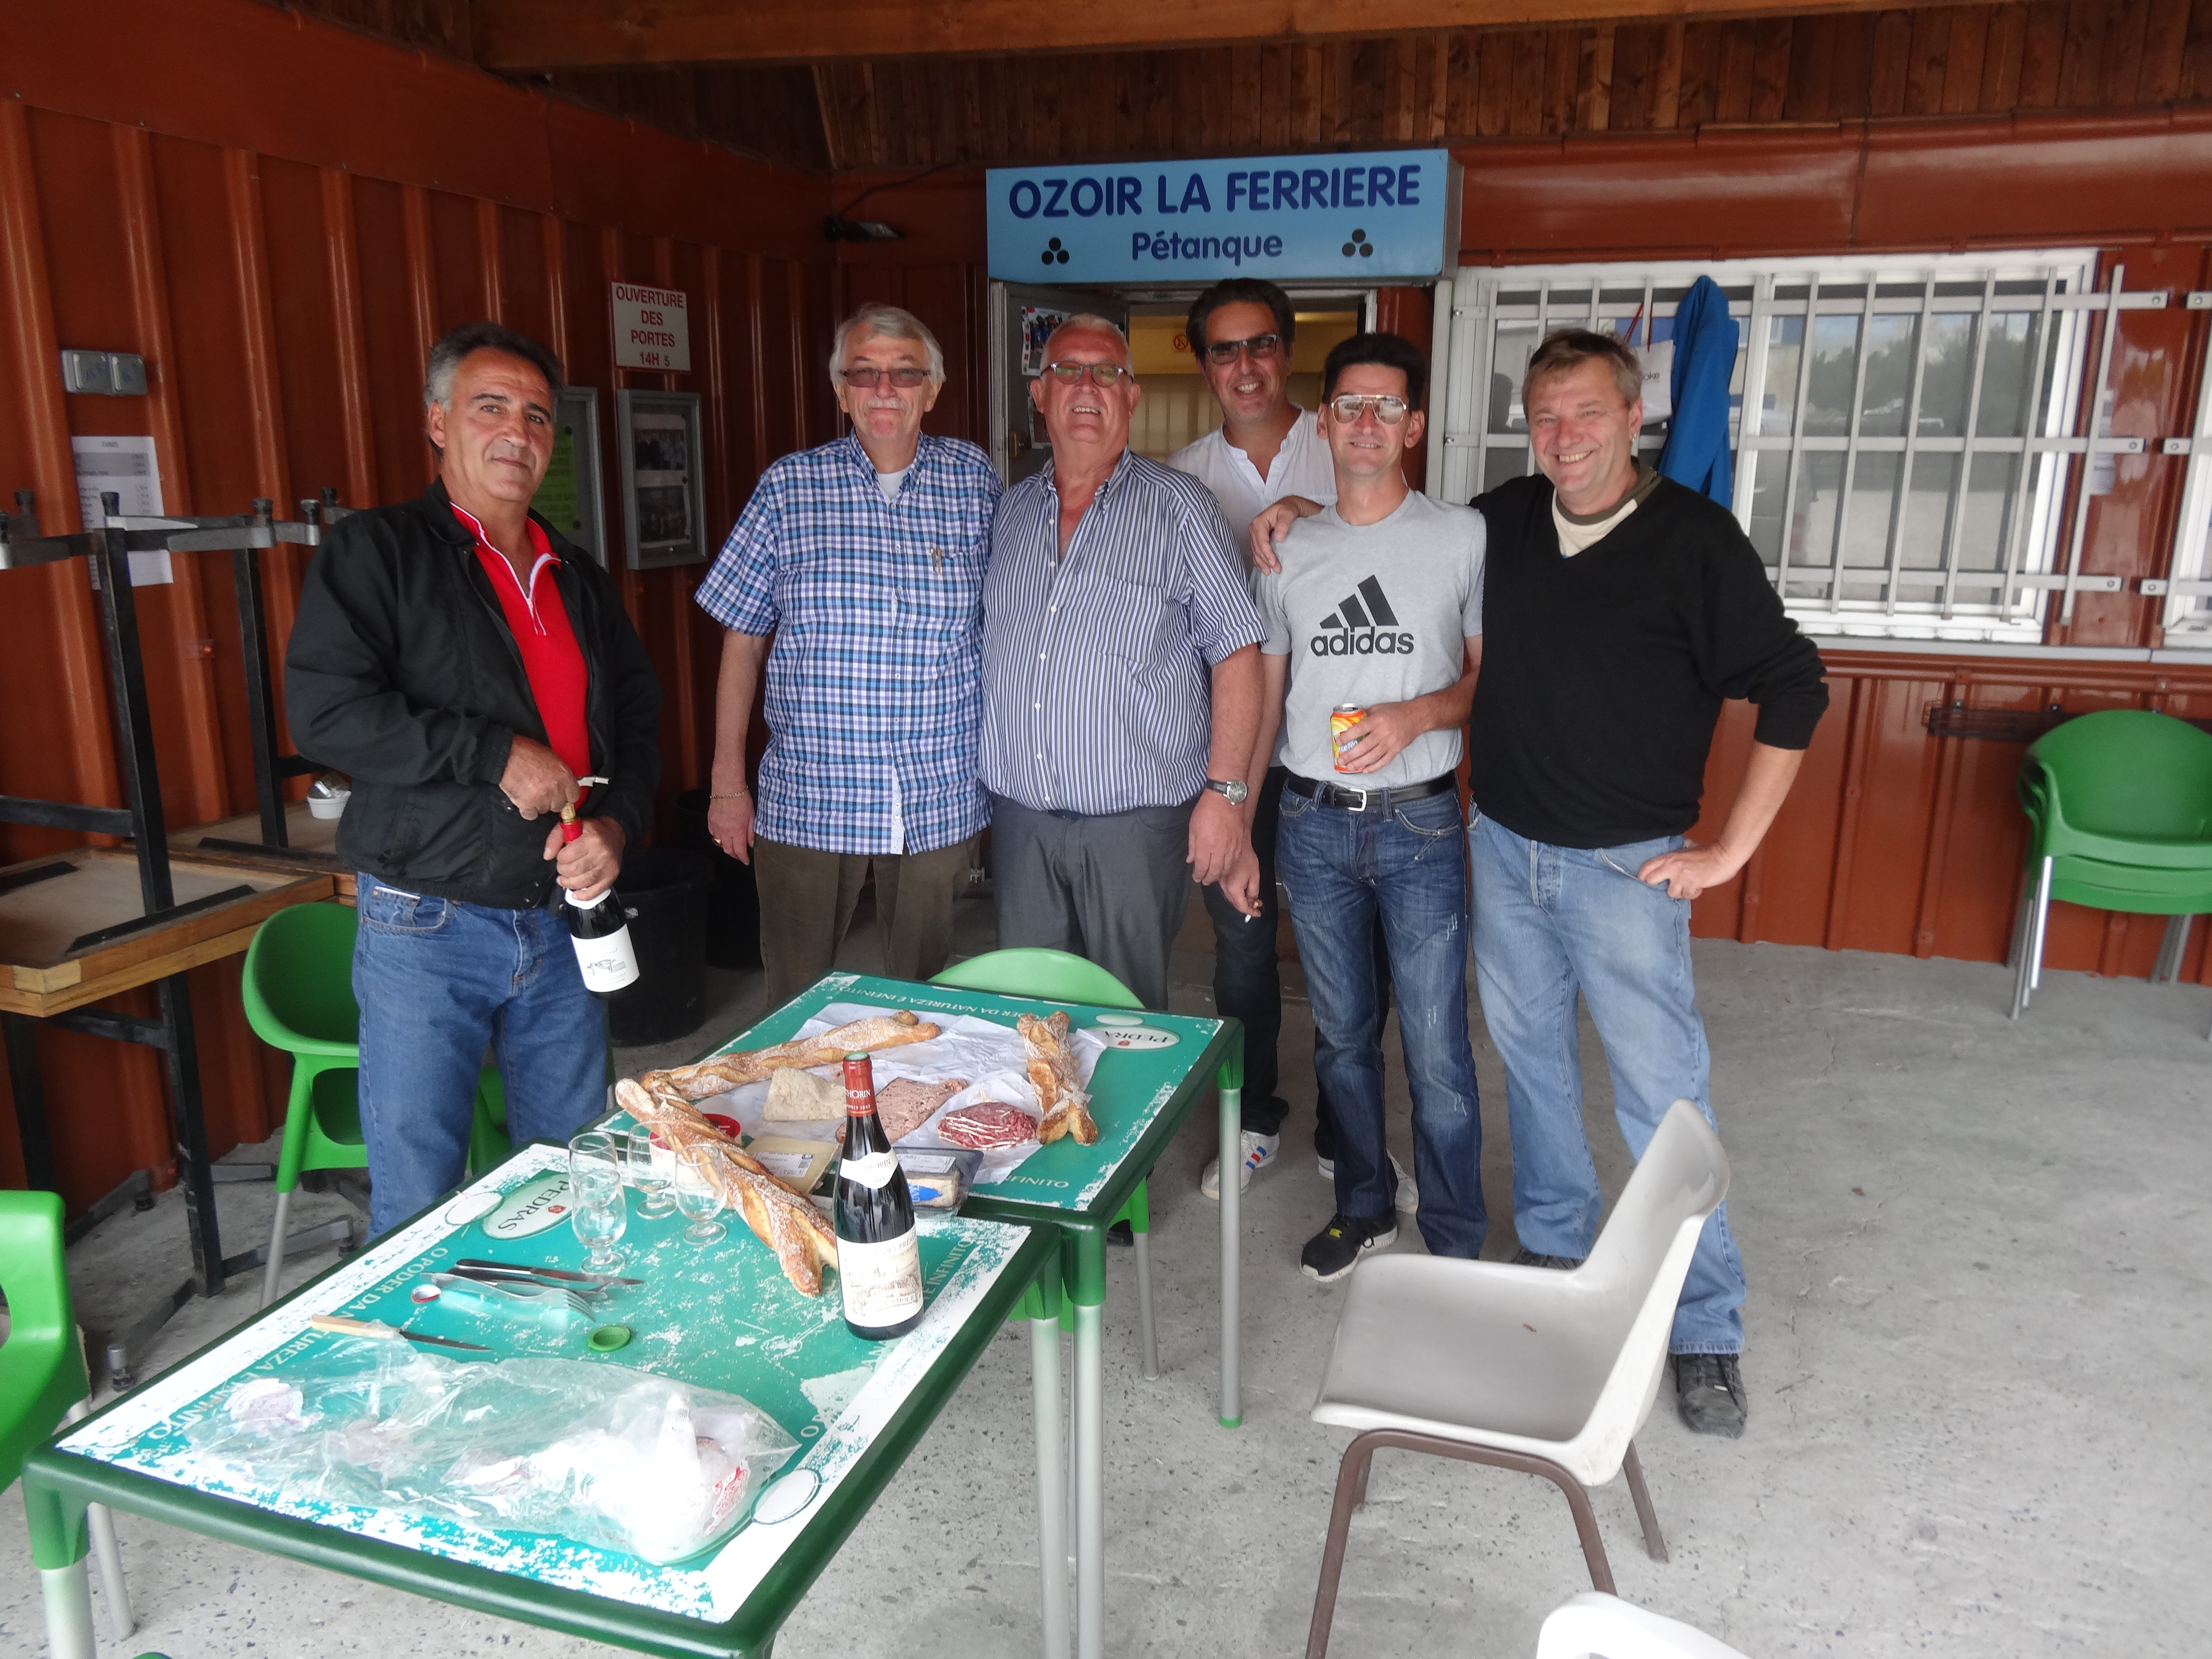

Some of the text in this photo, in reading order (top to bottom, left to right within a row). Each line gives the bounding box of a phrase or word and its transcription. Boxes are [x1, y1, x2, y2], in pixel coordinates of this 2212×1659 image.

[1009, 164, 1421, 219] OZOIR LA FERRIERE
[1132, 231, 1283, 266] Pétanque
[616, 286, 684, 309] OUVERTURE
[641, 309, 664, 326] DES
[631, 329, 675, 347] PORTES
[640, 351, 660, 366] 14H
[1310, 626, 1415, 656] adidas
[1103, 1030, 1168, 1043] PEDRA
[845, 1089, 871, 1099] HORIN
[498, 1180, 570, 1231] PEDRAS
[430, 1247, 448, 1258] O
[375, 1257, 435, 1293] PODER
[348, 1293, 382, 1310] DA
